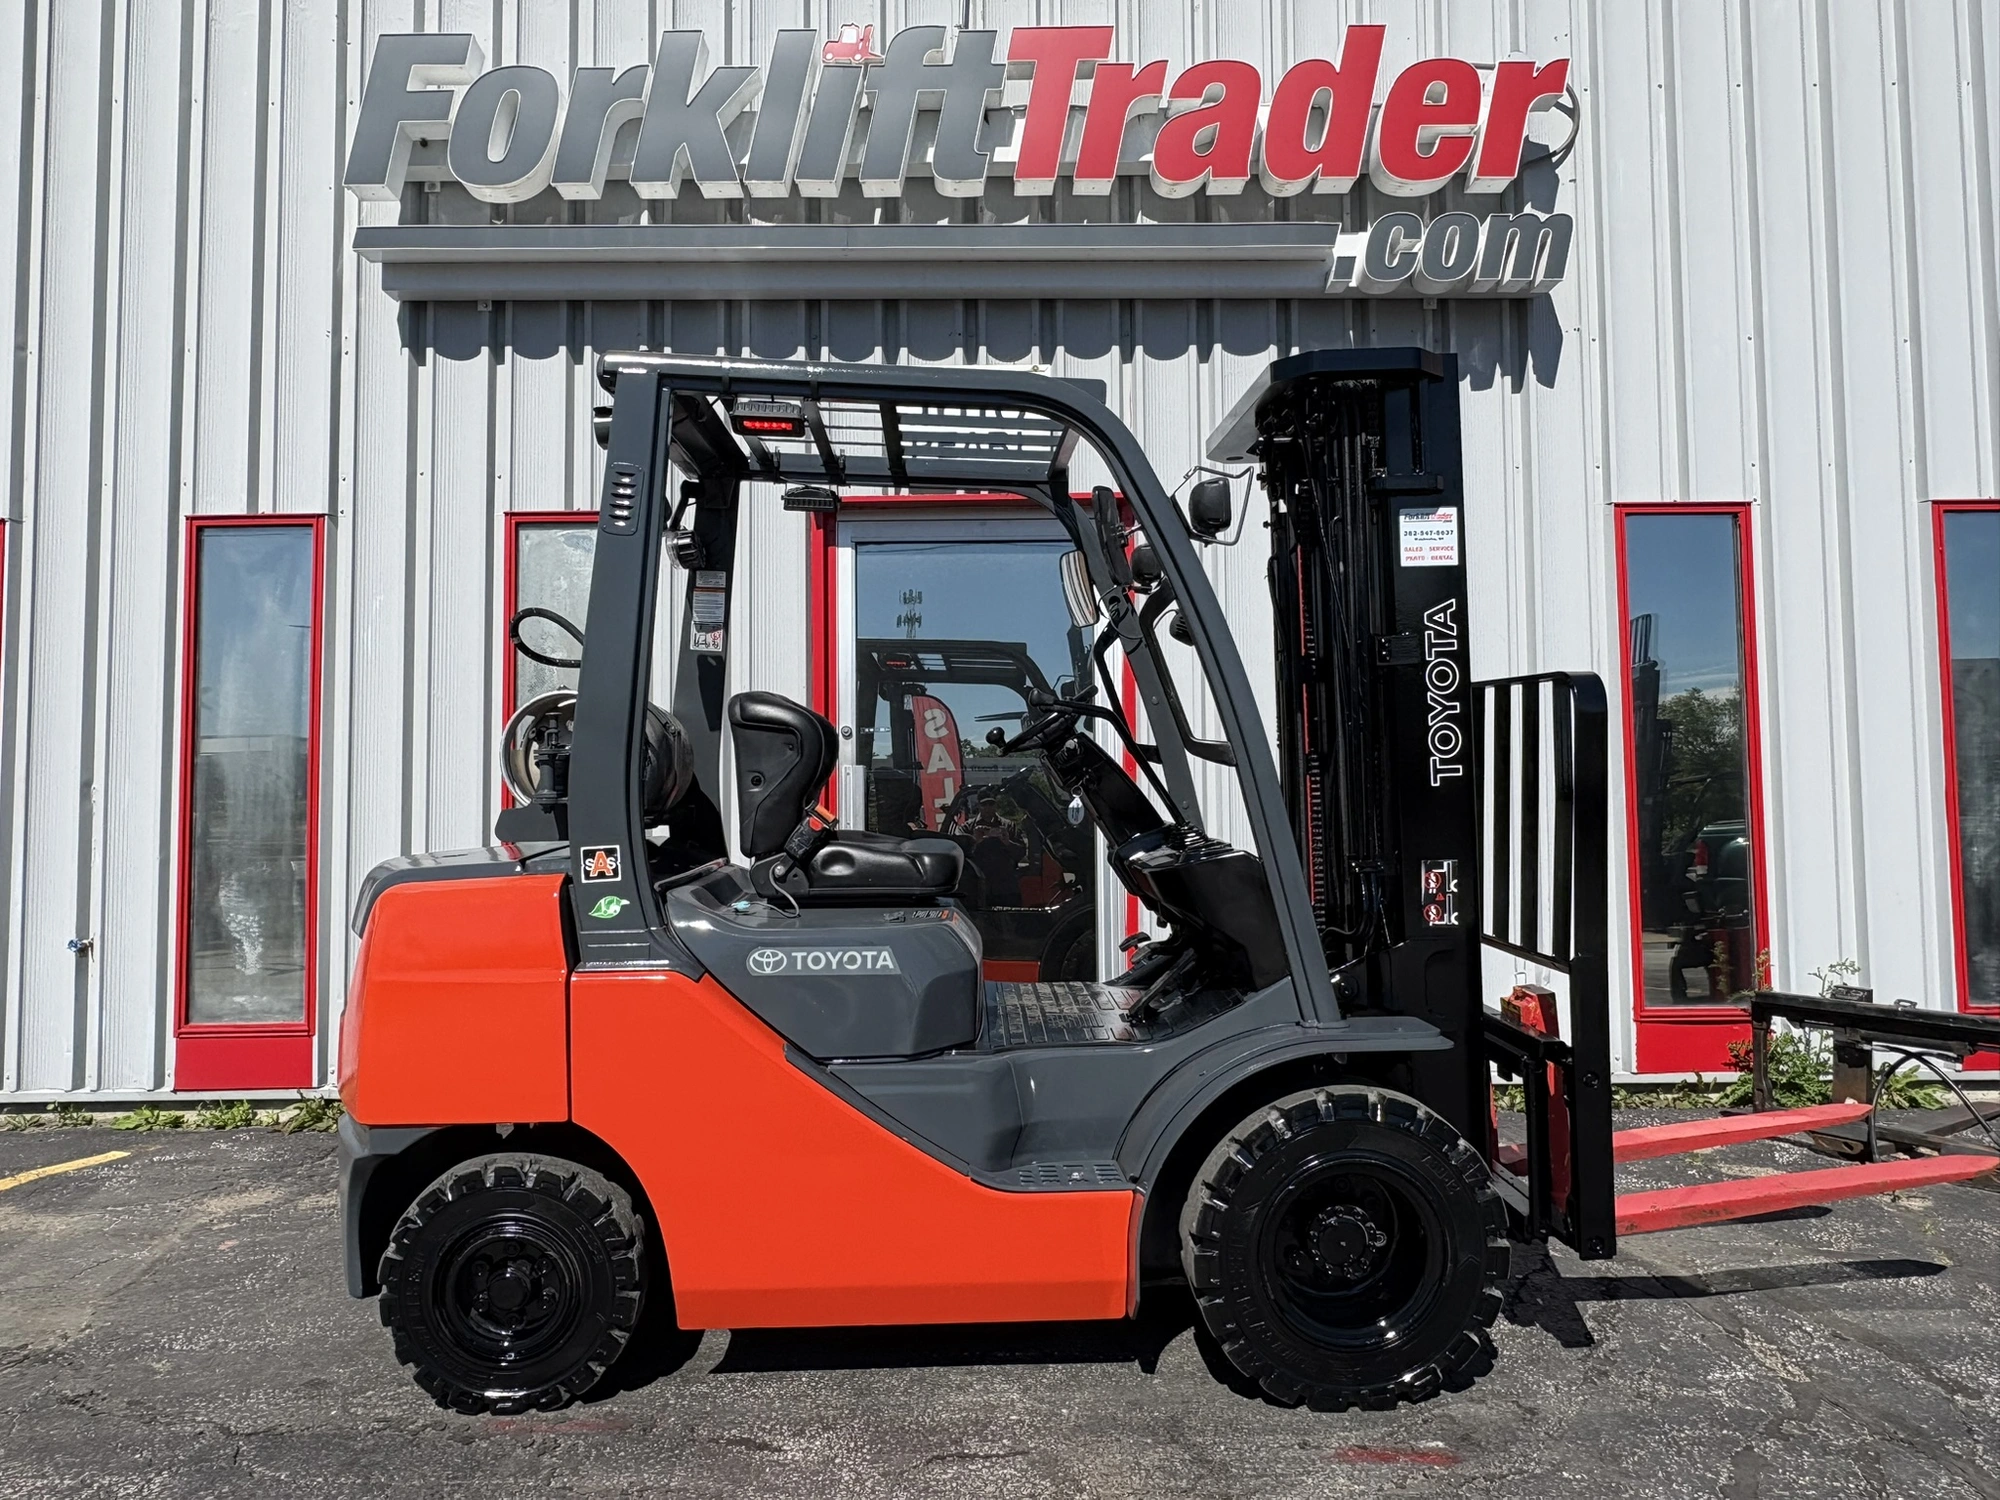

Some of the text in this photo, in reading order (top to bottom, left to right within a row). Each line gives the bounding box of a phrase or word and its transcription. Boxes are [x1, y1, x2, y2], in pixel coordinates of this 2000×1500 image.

[343, 25, 1570, 188] ForkliftTrader
[1333, 211, 1573, 281] .com
[1424, 598, 1462, 786] TOYOTA
[585, 851, 616, 877] SAS
[792, 951, 894, 970] TOYOTA
